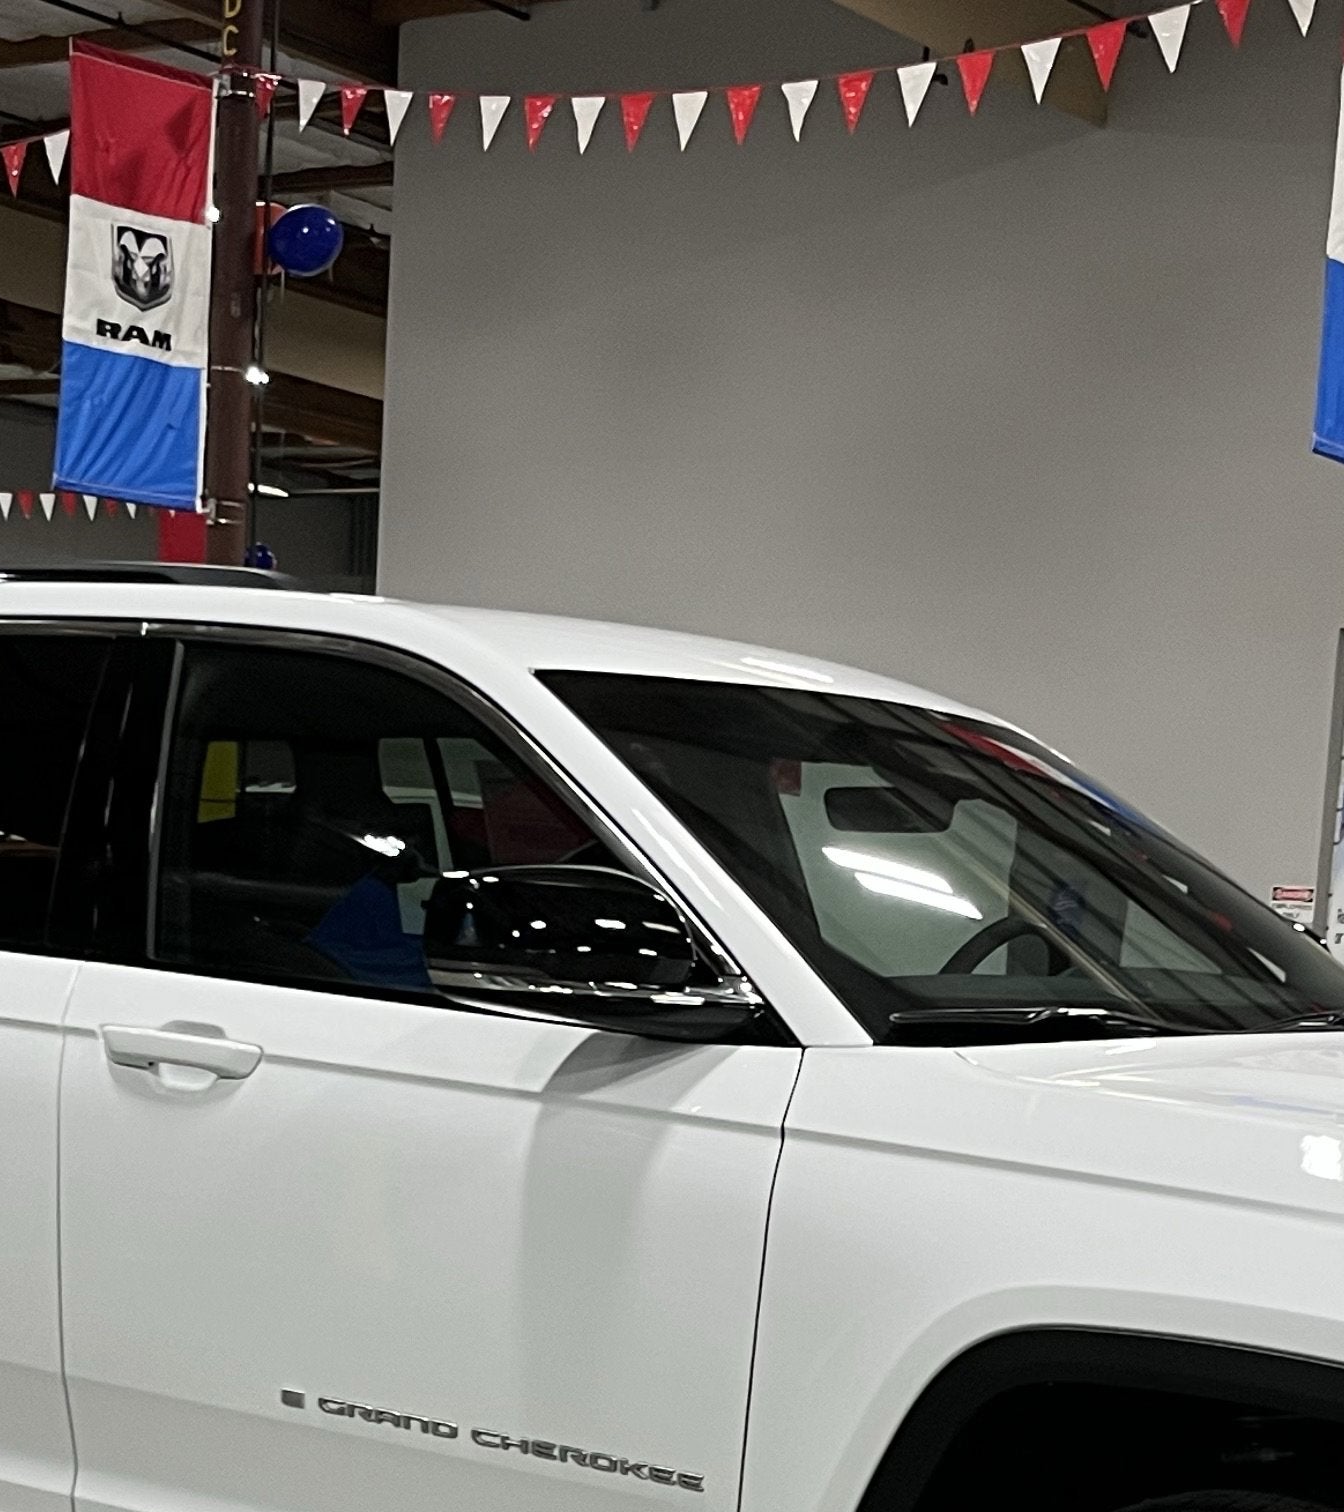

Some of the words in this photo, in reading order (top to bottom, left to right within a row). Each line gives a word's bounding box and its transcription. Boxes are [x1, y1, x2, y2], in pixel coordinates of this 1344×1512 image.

[96, 318, 172, 352] RAM
[317, 1396, 458, 1439] GRAND
[470, 1427, 705, 1493] CHEROKEE
